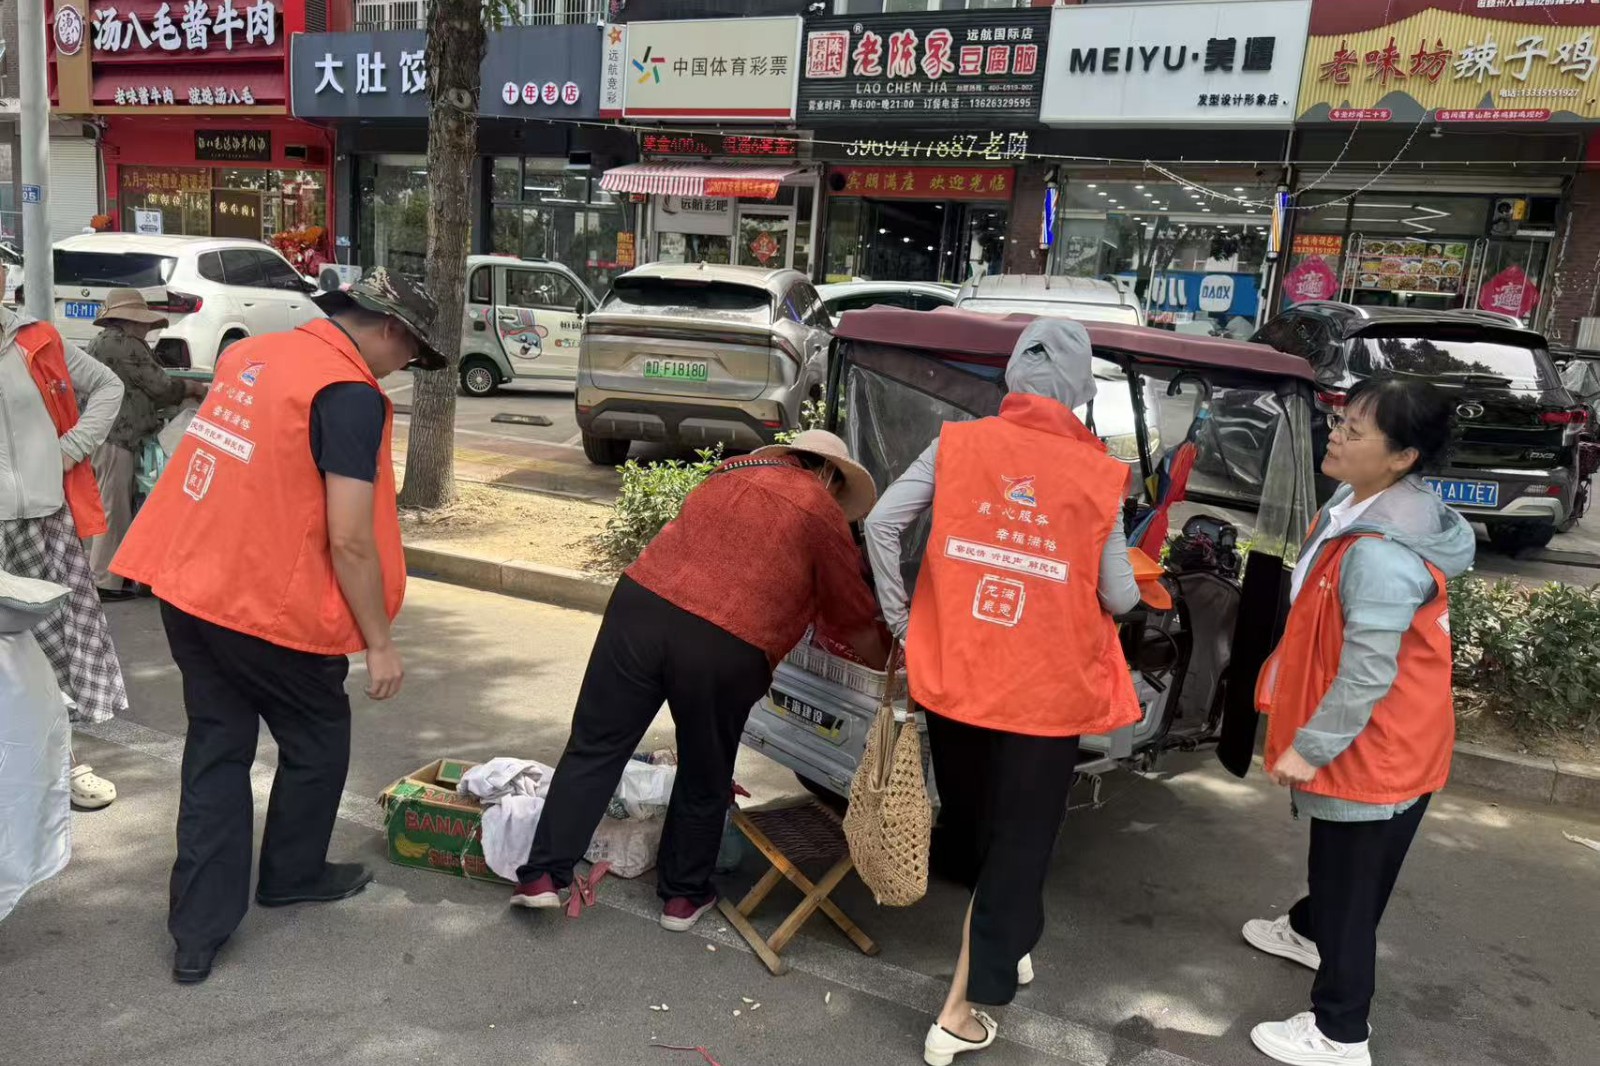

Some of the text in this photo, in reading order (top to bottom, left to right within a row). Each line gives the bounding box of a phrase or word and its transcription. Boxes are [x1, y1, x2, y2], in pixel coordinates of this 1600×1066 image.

[93, 1, 275, 51] 汤八毛酱牛肉
[966, 28, 1034, 41] 远航国际店
[852, 29, 1038, 79] 老陈家 豆腐脑
[673, 55, 788, 77] 中国体育彩票
[114, 86, 175, 105] 老味酱牛肉
[188, 86, 255, 105] 就选汤八毛
[504, 82, 579, 103] 十年老店
[856, 81, 948, 94] LAO CHEN JIA
[1197, 93, 1280, 107] 发型设计形象店
[846, 173, 1006, 191] 宾朋满座 欢迎光临
[1426, 481, 1496, 502] A·A17E7
[995, 528, 1057, 552] 幸福满格
